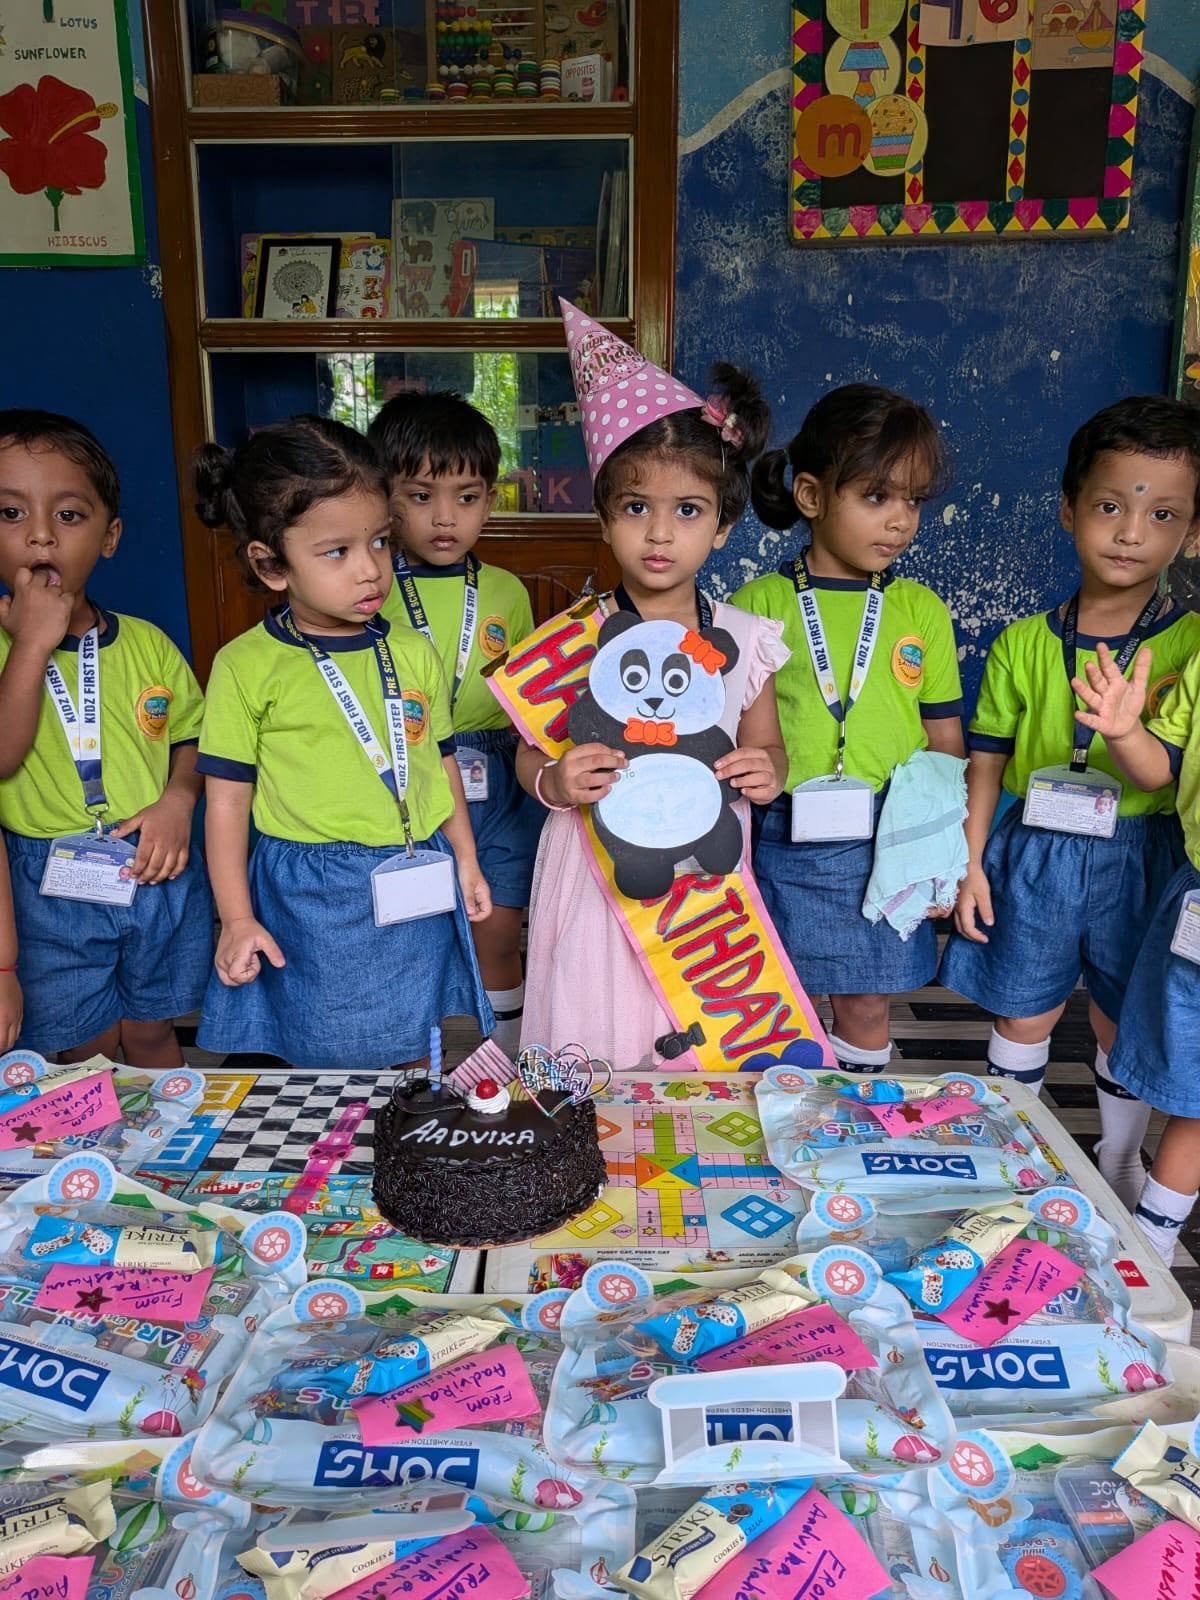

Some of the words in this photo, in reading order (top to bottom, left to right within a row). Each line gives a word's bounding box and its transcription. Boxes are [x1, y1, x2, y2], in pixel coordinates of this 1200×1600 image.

[60, 17, 98, 30] LOTUS
[14, 47, 88, 61] SUNFLOWER
[564, 64, 597, 78] OPPOSITES
[47, 236, 108, 249] HIBISCUS
[548, 476, 573, 505] K
[466, 589, 476, 609] STEP
[802, 594, 815, 619] STEP
[868, 593, 879, 615] STEP
[463, 610, 473, 633] FIRST
[862, 615, 875, 645] FIRST
[83, 633, 96, 661] STEP
[461, 634, 470, 653] KIDZ
[808, 621, 823, 650] FIRST
[814, 650, 829, 672] KIDZ
[857, 646, 869, 668] KIDZ
[83, 663, 97, 695] FIRST
[323, 663, 344, 693] STEP
[387, 675, 399, 696] PRE
[61, 696, 77, 723] KIDZ
[83, 697, 97, 724] KIDZ
[338, 692, 359, 722] FIRST
[389, 702, 402, 729] STEP
[351, 720, 371, 743] KIDZ
[391, 730, 405, 762] FIRST
[395, 763, 408, 789] KIDZ
[631, 1082, 655, 1101] 3
[703, 1081, 733, 1099] 5
[401, 1118, 535, 1147] AADVIKA
[871, 1154, 975, 1176] DOMS
[124, 1229, 189, 1244] STRIKE
[1118, 1268, 1140, 1279] llo
[115, 1323, 184, 1347] ART
[0, 1347, 100, 1403] DOM
[932, 1352, 1061, 1384] DOMS
[420, 1361, 507, 1402] Aadvika
[412, 1438, 451, 1446] AMBITION
[451, 1438, 473, 1447] EVERY
[323, 1449, 472, 1487] DOMS
[651, 1507, 713, 1567] STRIKE
[352, 1554, 386, 1574] COOKIES
